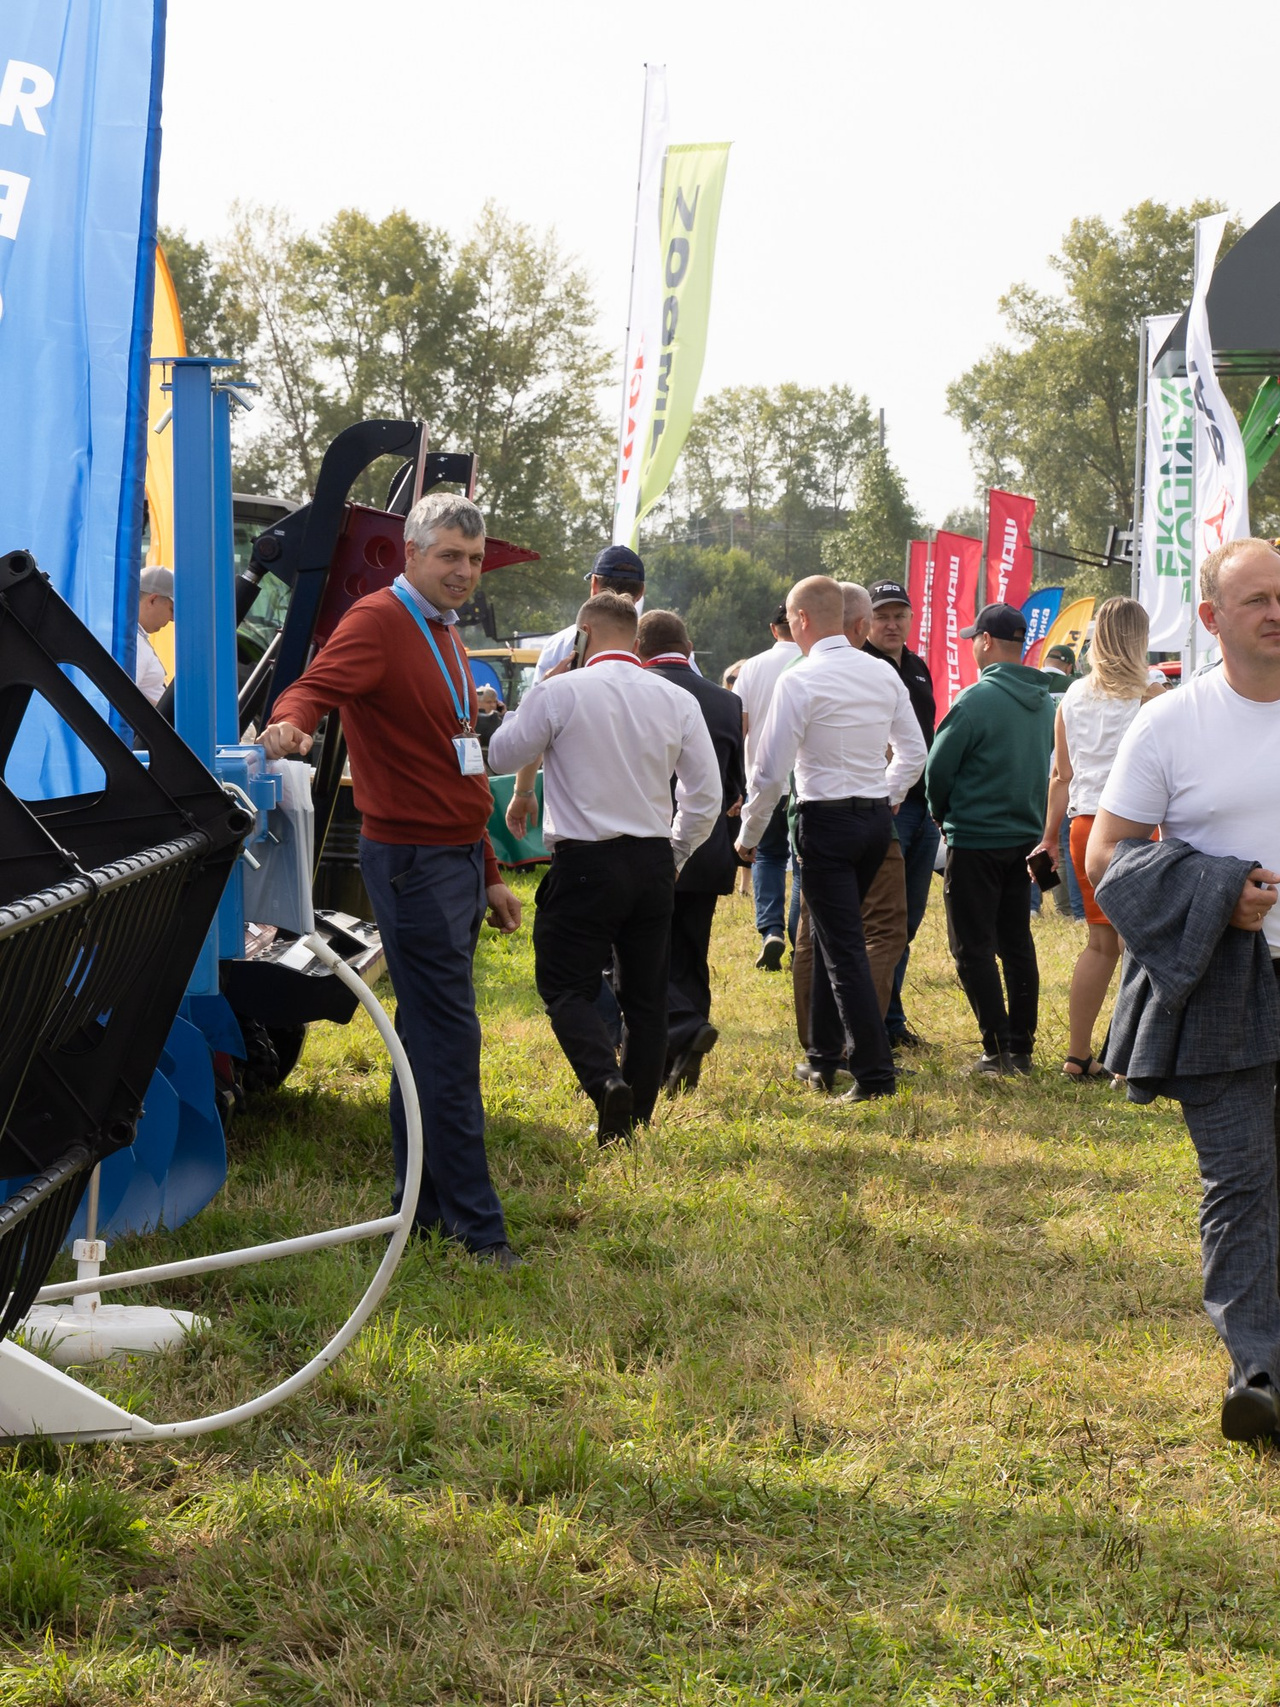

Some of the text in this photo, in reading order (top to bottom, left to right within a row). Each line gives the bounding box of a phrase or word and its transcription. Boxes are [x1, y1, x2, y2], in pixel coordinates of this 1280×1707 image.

[645, 184, 700, 475] ZOOML
[874, 584, 901, 593] TSG
[945, 554, 961, 706] ТСЕЛЬМАШ
